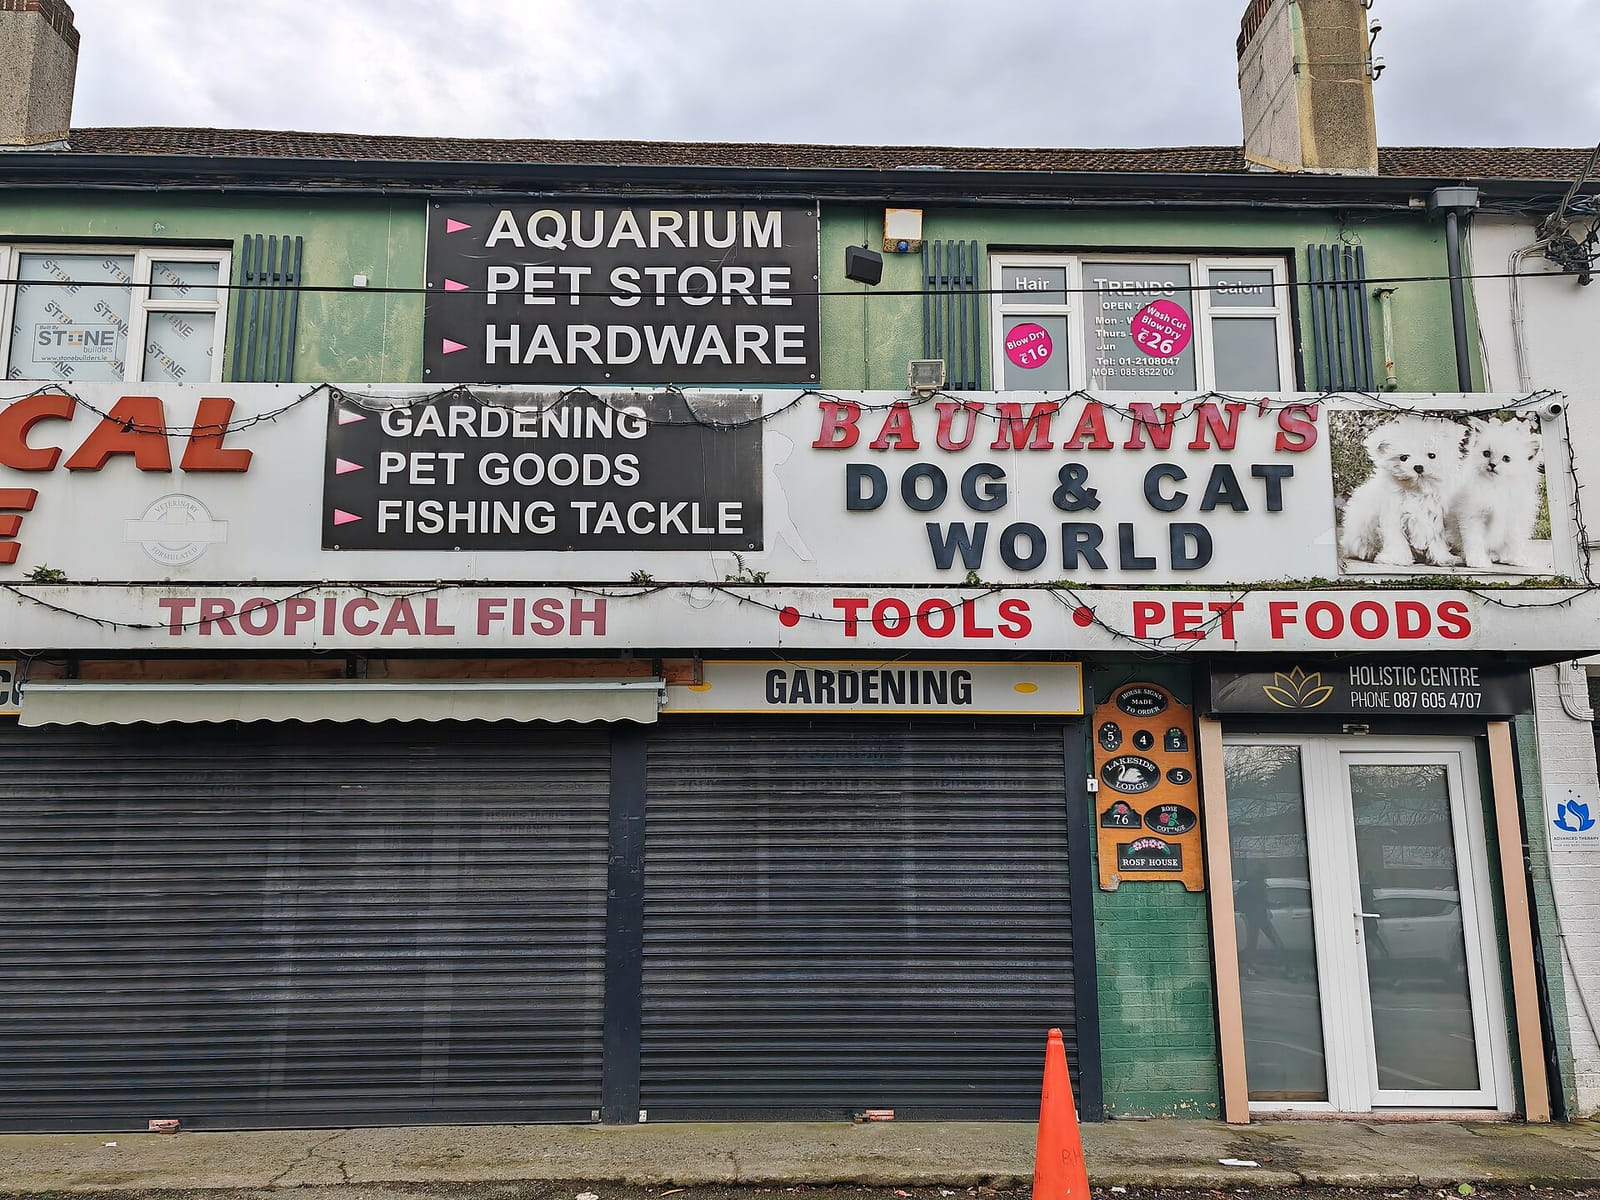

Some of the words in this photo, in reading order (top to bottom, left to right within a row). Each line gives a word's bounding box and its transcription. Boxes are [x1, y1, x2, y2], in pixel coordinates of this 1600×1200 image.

[485, 210, 782, 251] AQUARIUM
[487, 266, 591, 305] PET
[609, 266, 793, 306] STORE
[1015, 276, 1050, 290] Hair
[1217, 280, 1263, 294] Salon
[1103, 302, 1132, 310] OPEN
[1095, 317, 1117, 325] Mon
[1147, 306, 1171, 323] Wash
[1171, 318, 1187, 330] Cut
[1096, 330, 1127, 338] Thurs
[1141, 315, 1164, 331] Blow
[1164, 326, 1181, 340] Dry
[485, 324, 807, 364] HARDWARE
[1007, 337, 1029, 350] Blow
[1028, 330, 1045, 341] Dry
[1119, 357, 1180, 366] 01-2108047
[1120, 368, 1137, 376] 085
[1139, 368, 1161, 376] 8522
[380, 405, 648, 439] GARDENING
[811, 397, 1319, 452] BAUMANN'S
[0, 395, 253, 473] CAL
[378, 453, 467, 485] PET
[478, 453, 640, 486] GOODS
[846, 463, 1008, 511] DOG
[1052, 463, 1101, 511] &
[1143, 463, 1294, 511] CAT
[154, 499, 200, 513] VETERINARY
[377, 501, 556, 534] FISHING
[570, 501, 743, 534] TACKLE
[926, 522, 1213, 571] WORLD
[158, 597, 455, 636] TROPICAL
[477, 597, 607, 636] FISH
[833, 598, 1032, 639] TOOLS
[1132, 601, 1244, 640] PET
[1269, 601, 1471, 640] FOODS
[1350, 666, 1416, 687] HOLISTIC
[1421, 667, 1480, 687] CENTRE
[765, 669, 972, 705] GARDENING
[1122, 689, 1141, 700] HOUSE
[1144, 689, 1163, 700] SIGNS
[1351, 692, 1390, 708] PHONE
[1394, 692, 1416, 709] 087
[1421, 692, 1446, 709] 605
[1449, 692, 1482, 709] 4707
[1138, 706, 1160, 715] ORDER
[1107, 731, 1115, 741] 5
[1139, 735, 1147, 745] 4
[1173, 738, 1181, 748] 5
[1106, 757, 1155, 771] LAKESIDE
[1176, 771, 1184, 781] 5
[1115, 781, 1149, 790] LODGE
[1113, 815, 1129, 825] 76
[1149, 858, 1179, 866] HOUSE
